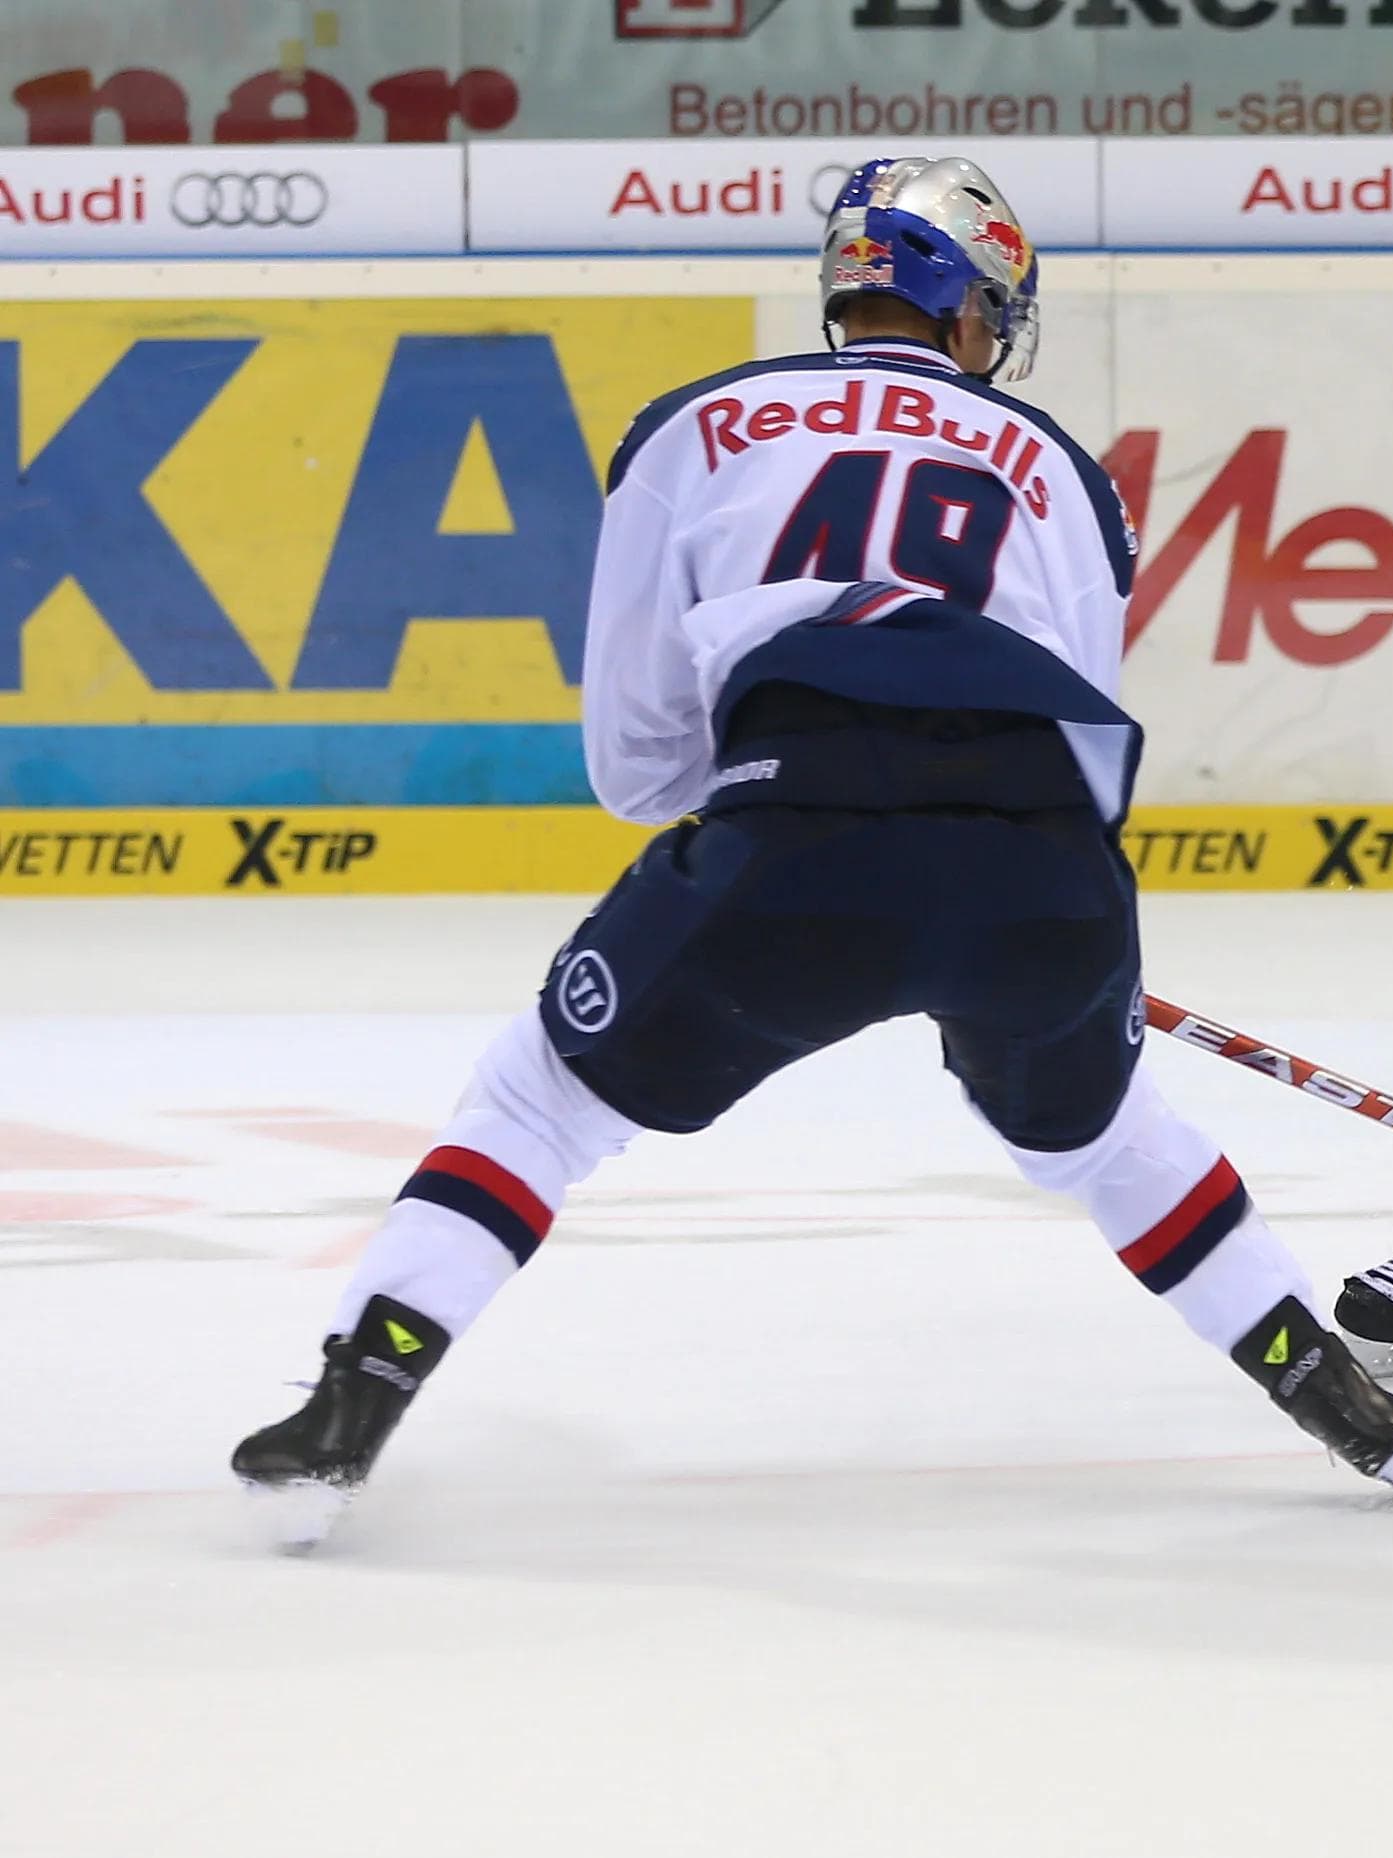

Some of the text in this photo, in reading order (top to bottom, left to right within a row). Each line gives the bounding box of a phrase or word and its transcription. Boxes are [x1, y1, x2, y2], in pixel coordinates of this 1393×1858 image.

[669, 83, 1057, 136] Betonbohren
[1082, 82, 1192, 136] und
[0, 175, 146, 224] Audi
[609, 168, 784, 217] Audi
[835, 264, 894, 283] Red Bull
[697, 380, 865, 475] Red
[875, 384, 1051, 521] Bulls
[760, 449, 1017, 615] 49
